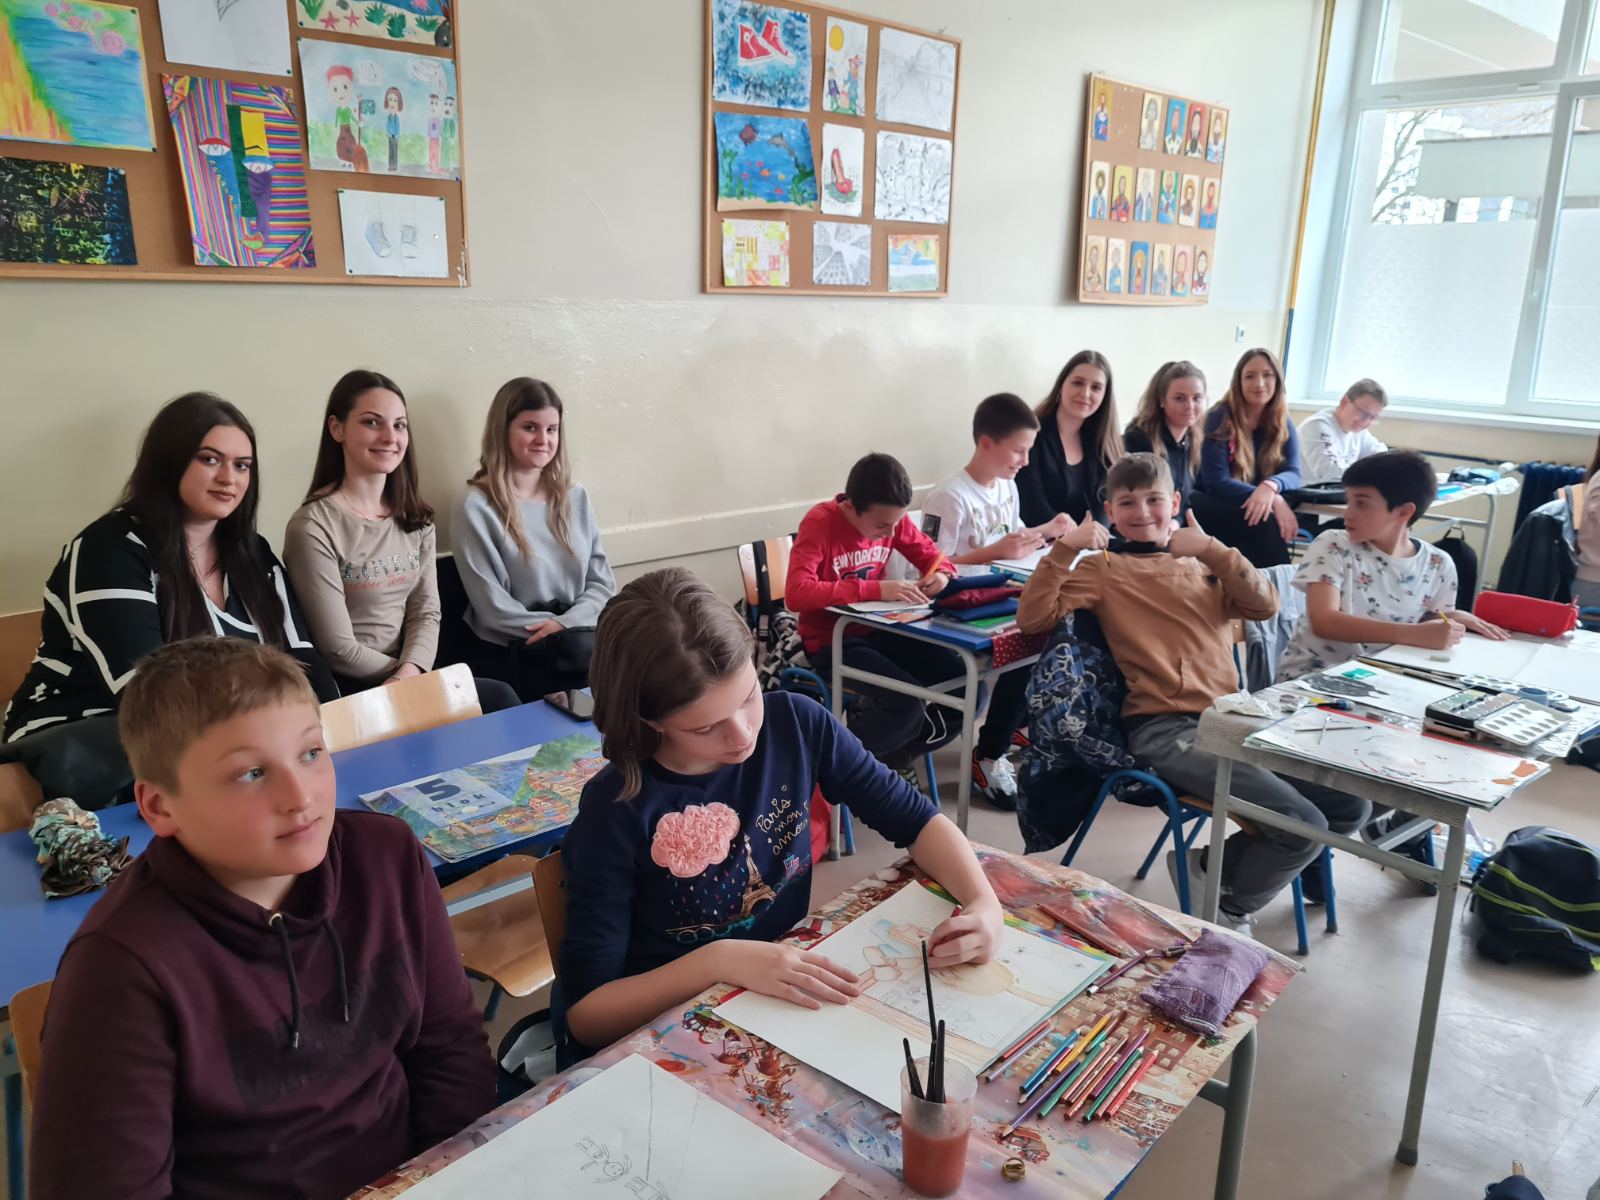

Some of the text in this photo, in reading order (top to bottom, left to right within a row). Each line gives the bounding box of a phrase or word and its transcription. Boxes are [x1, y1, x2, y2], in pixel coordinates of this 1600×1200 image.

[414, 778, 461, 802] 5
[431, 794, 486, 812] blok
[755, 798, 791, 833] Paris
[775, 810, 803, 833] mon
